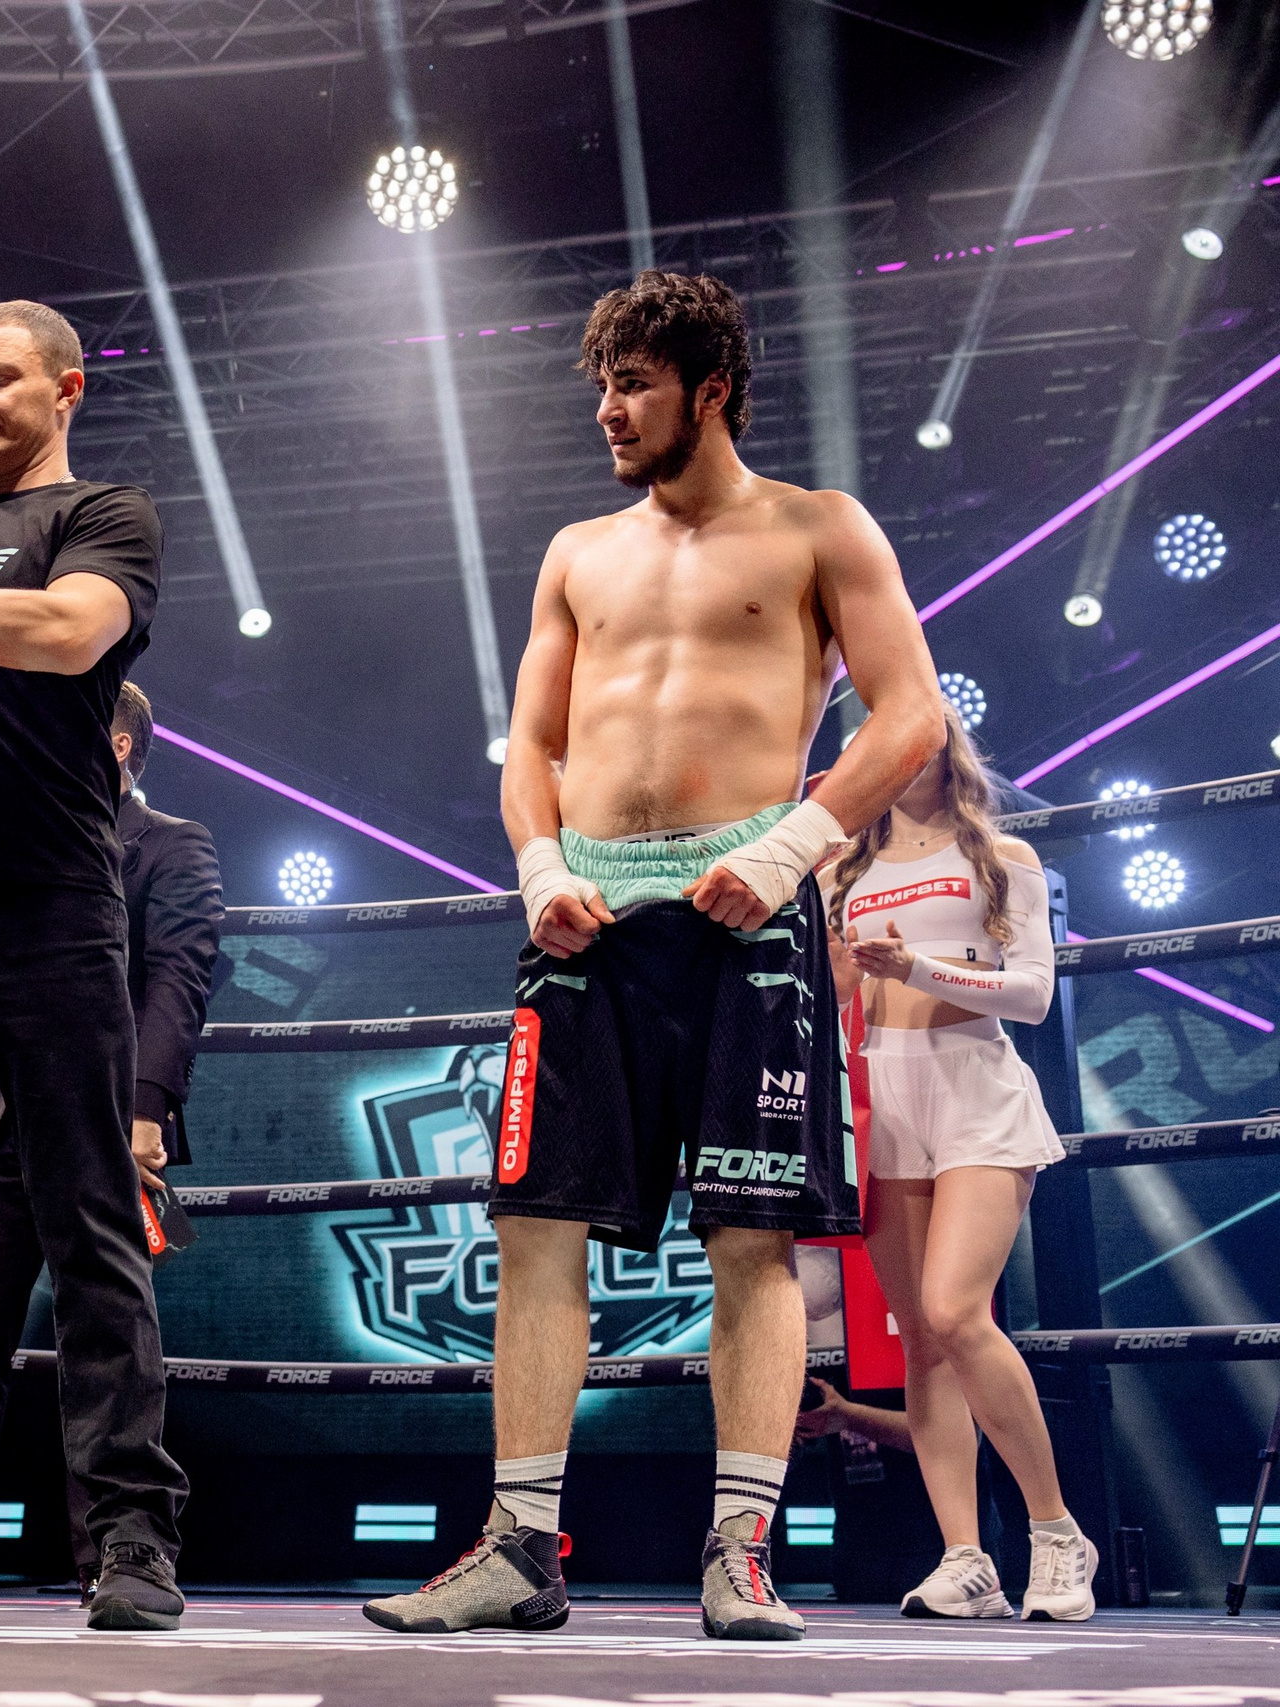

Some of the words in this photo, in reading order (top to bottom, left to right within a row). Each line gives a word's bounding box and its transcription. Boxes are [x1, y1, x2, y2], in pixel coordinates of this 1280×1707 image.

[1203, 778, 1275, 805] FORCE
[1092, 796, 1162, 821] FORCE
[994, 811, 1052, 833] ORCE
[446, 896, 507, 914] FORCE
[851, 879, 964, 914] OLIMPBET
[248, 910, 309, 925] FORCE
[346, 906, 408, 922] FORCE
[1239, 924, 1280, 944] FOR
[1125, 935, 1198, 959] FORCE
[932, 971, 1005, 991] OLIMPBET
[250, 1023, 313, 1037] FORCE
[349, 1018, 413, 1034] FORCE
[449, 1014, 512, 1031] FORCE
[503, 1021, 529, 1171] OLIMPBET
[1125, 1129, 1199, 1151] FORCE
[1242, 1122, 1280, 1141] FOR
[694, 1146, 807, 1185] FORCE
[267, 1186, 331, 1203] FORCE
[369, 1181, 433, 1197] FORCE
[141, 1204, 161, 1247] OLIM
[1014, 1336, 1074, 1352] ORCE
[1114, 1333, 1192, 1350] FORCE
[1234, 1329, 1280, 1346] FOR
[166, 1365, 230, 1382] FORCE
[267, 1369, 332, 1384] FORCE
[369, 1370, 434, 1386] FORCE
